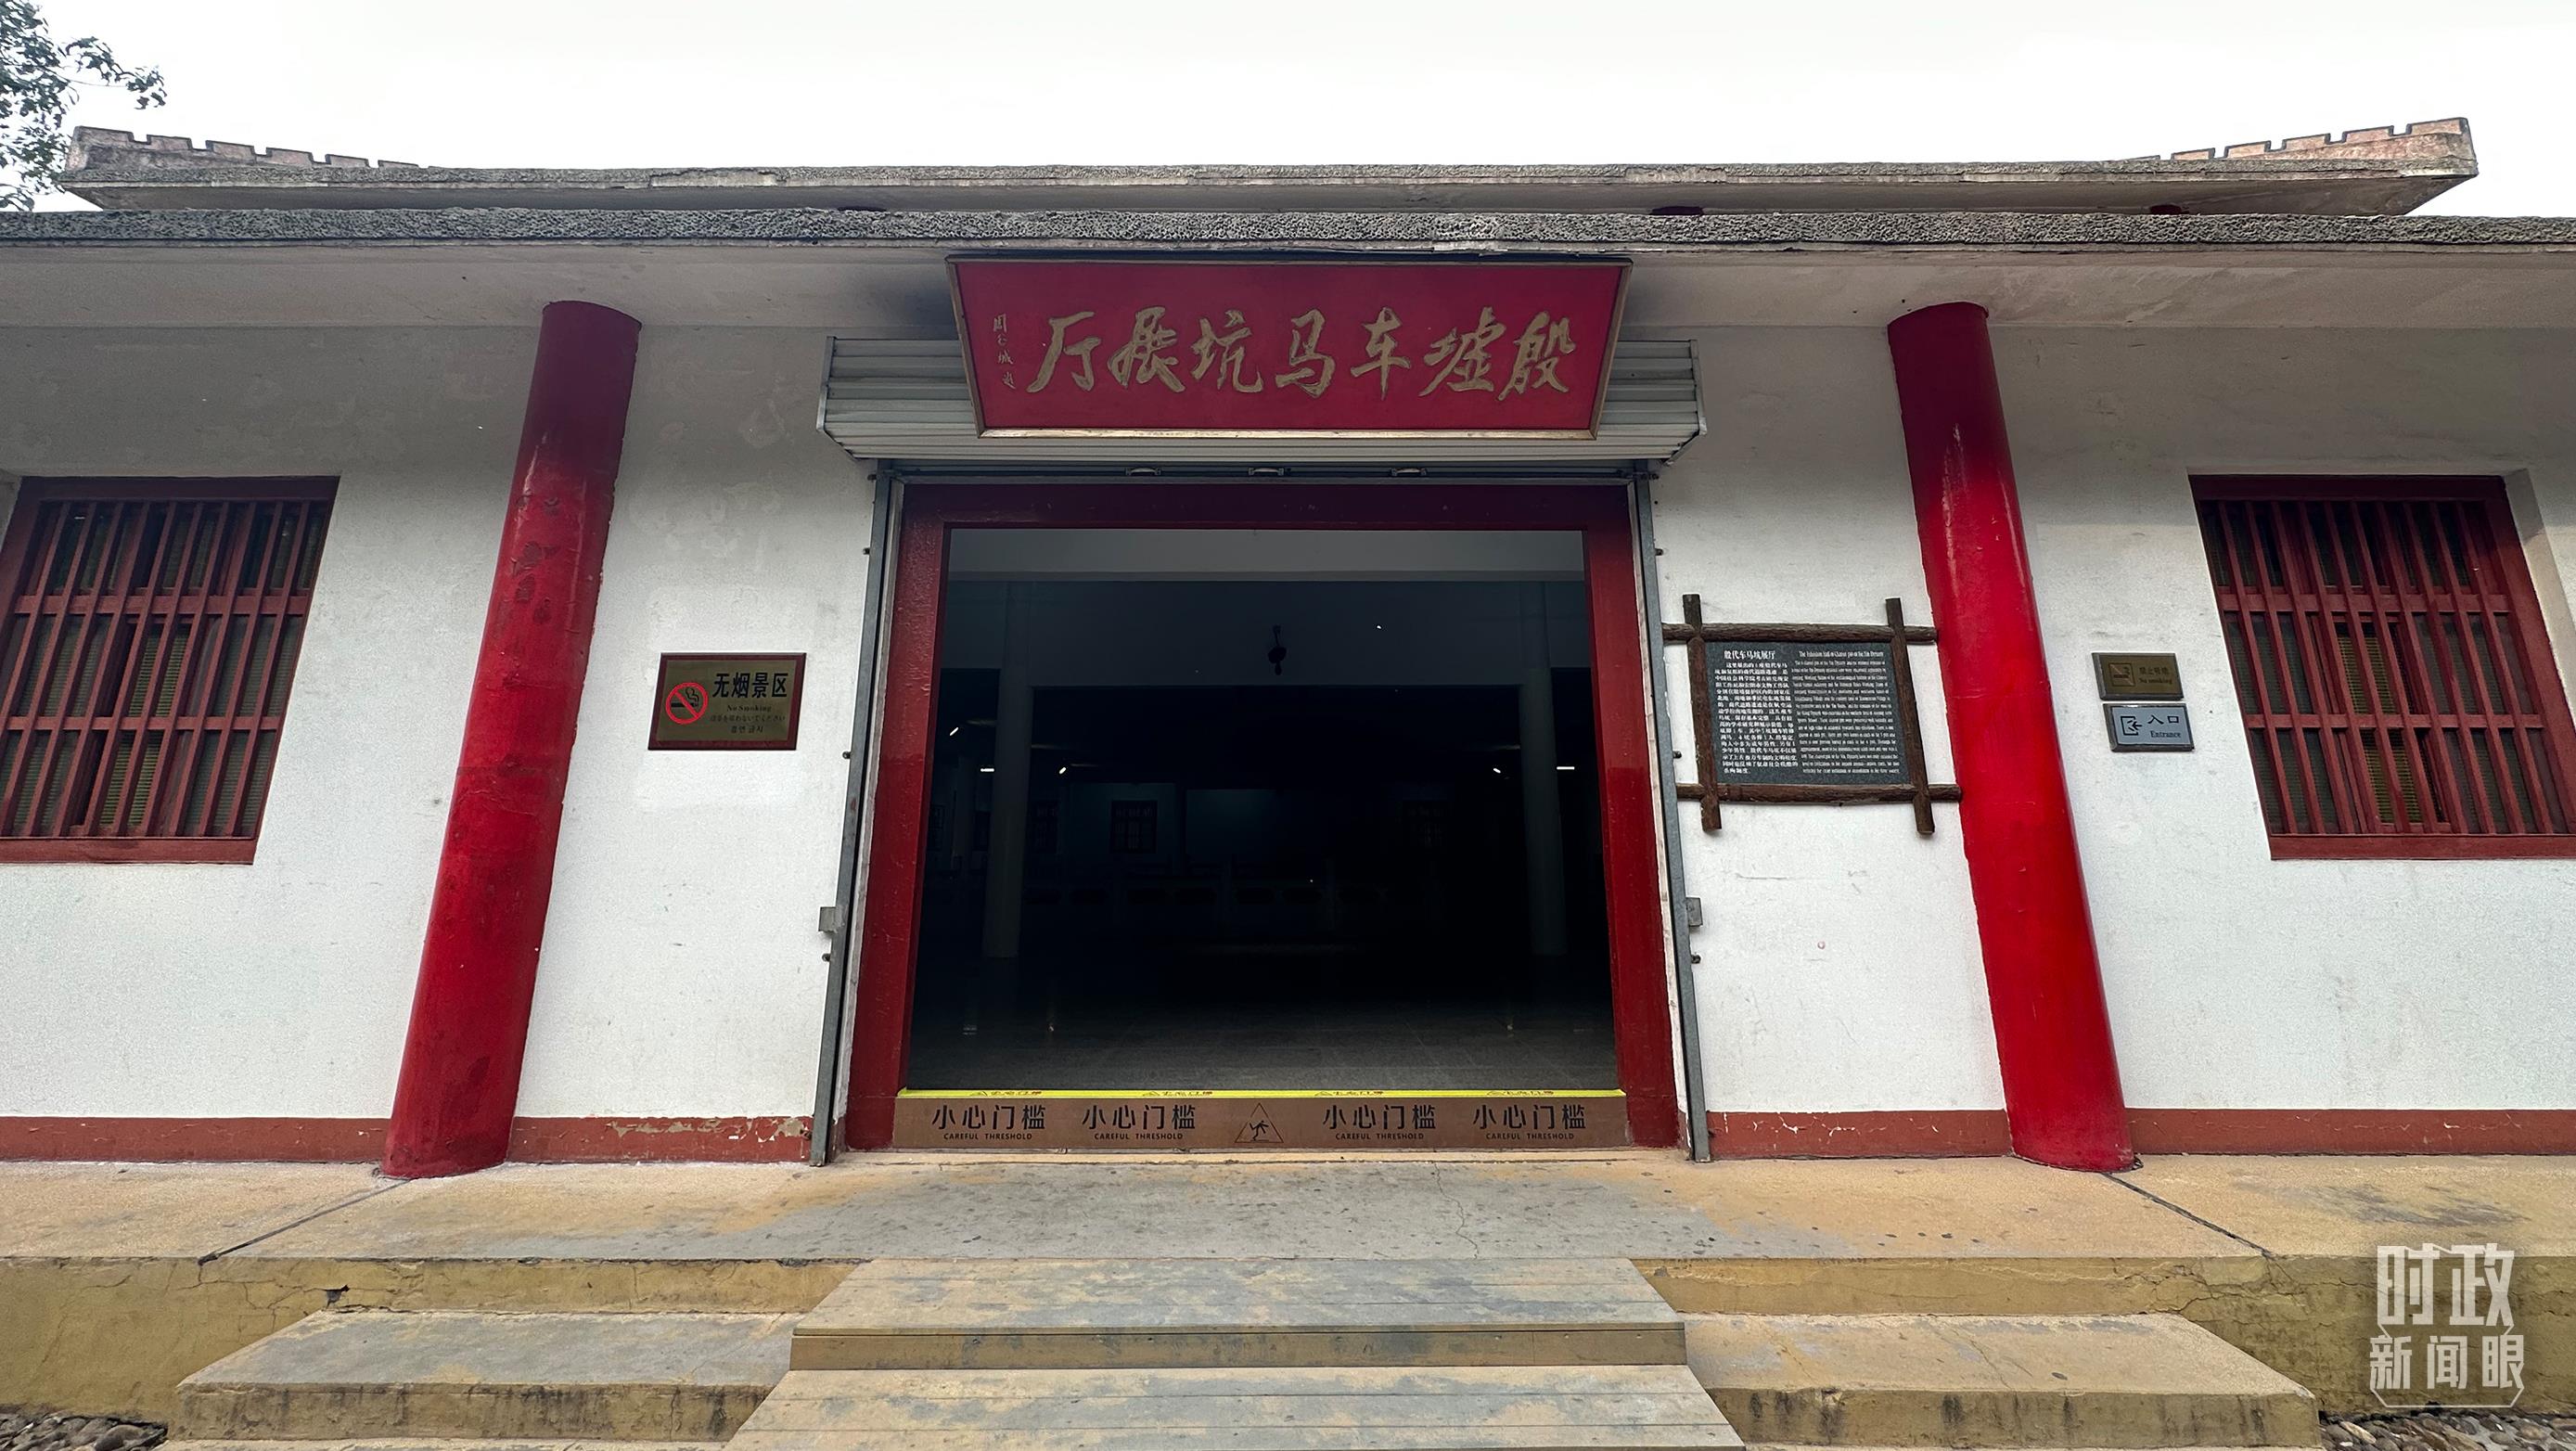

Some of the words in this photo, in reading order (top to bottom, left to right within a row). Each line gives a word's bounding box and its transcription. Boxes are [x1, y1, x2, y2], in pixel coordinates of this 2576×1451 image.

[1026, 306, 1576, 401] 殷墟车马坑展厅
[712, 673, 789, 699] 无烟景区
[2147, 714, 2180, 725] 入口
[2150, 730, 2182, 738] Entrance
[931, 1104, 1046, 1131] 小心门槛
[1082, 1104, 1196, 1131] 小心门槛
[1323, 1104, 1437, 1130] 小心门槛
[1473, 1104, 1586, 1130] 小心门槛
[943, 1132, 980, 1140] CAREFUL
[985, 1132, 1032, 1140] THRESHOLD
[1094, 1132, 1130, 1140] CAREFUL
[1135, 1132, 1183, 1140] THRESHOLD
[1335, 1132, 1371, 1140] CAREFUL
[1376, 1132, 1424, 1140] THRESHOLD
[1486, 1132, 1521, 1140] CAREFUL
[1526, 1132, 1575, 1140] THRESHOLD
